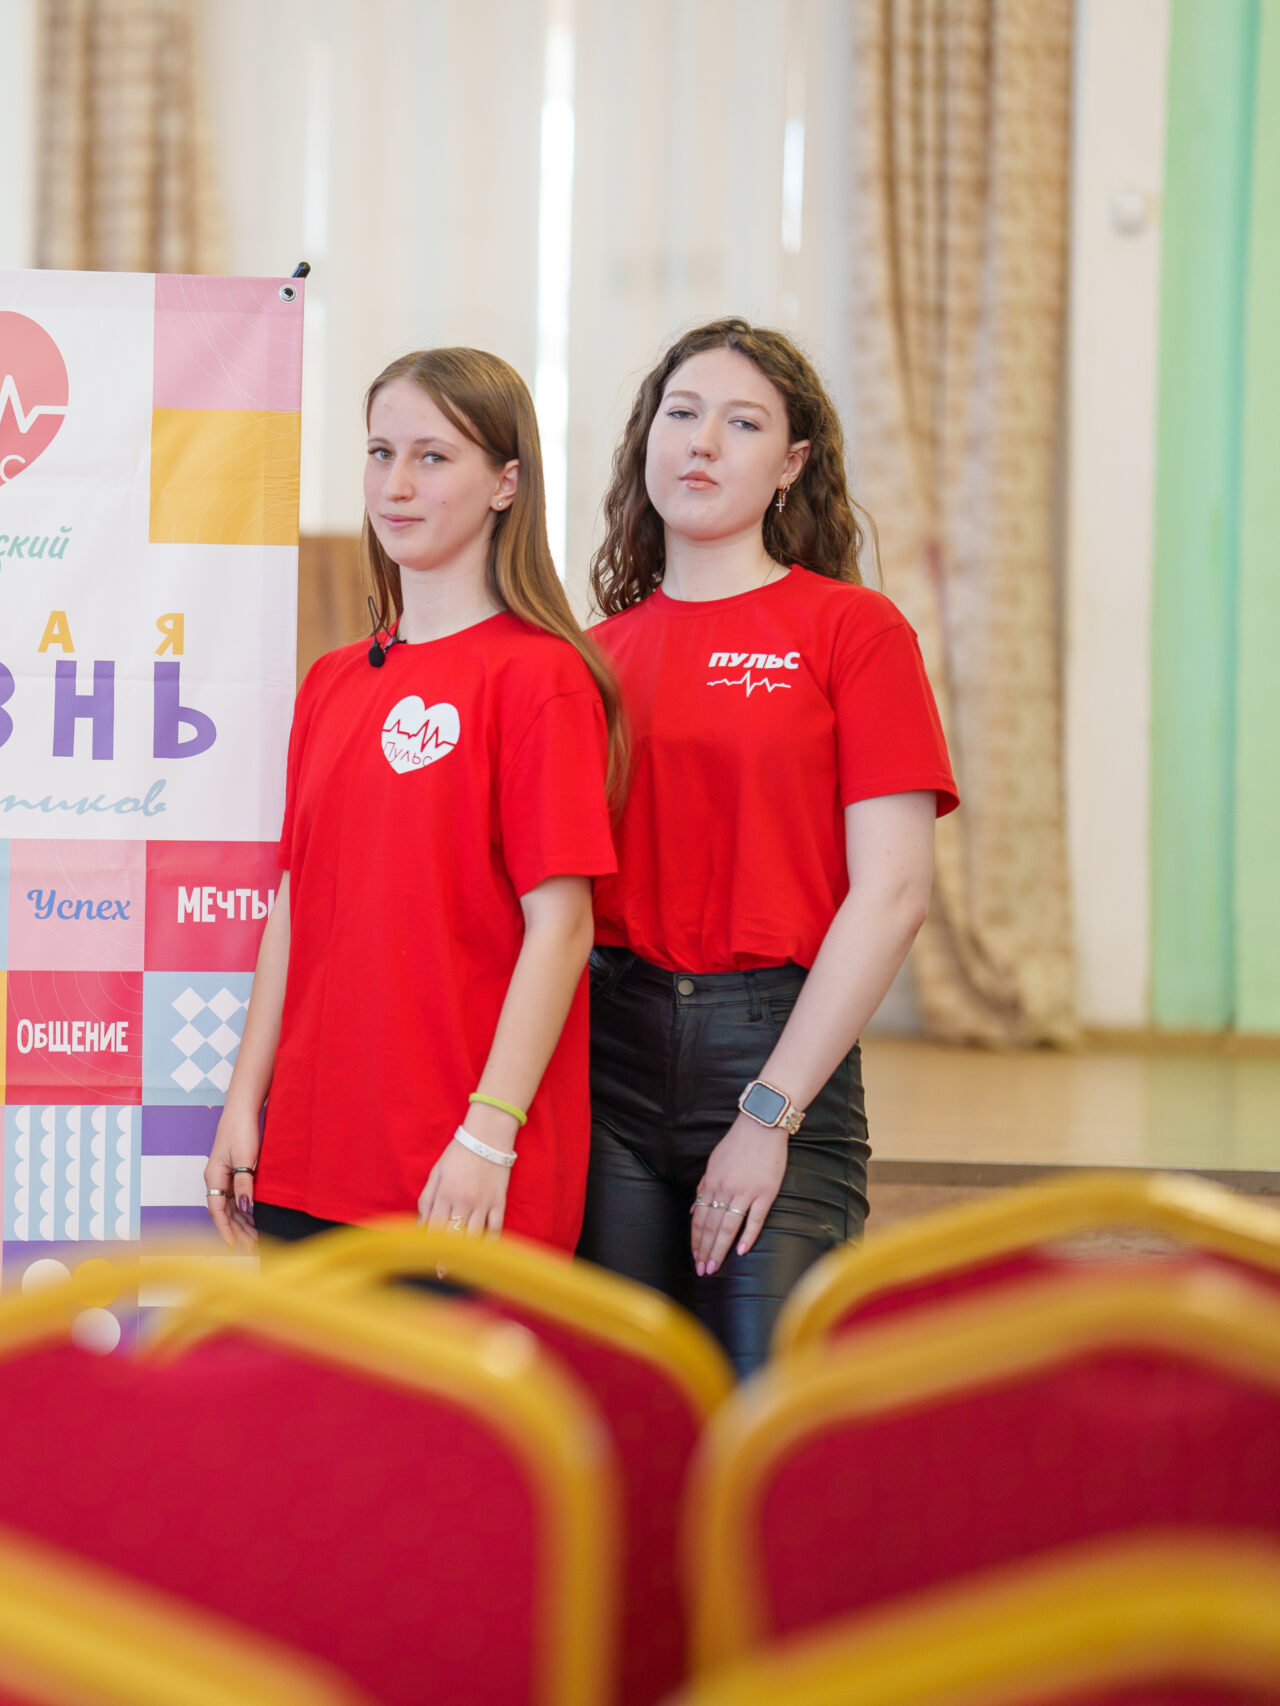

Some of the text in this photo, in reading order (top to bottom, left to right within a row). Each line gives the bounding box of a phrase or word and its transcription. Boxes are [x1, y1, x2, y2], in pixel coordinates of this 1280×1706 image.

[708, 651, 801, 669] ПУЛЬС
[384, 741, 433, 767] Пульс
[26, 889, 130, 920] Успех
[177, 886, 276, 923] МЕЧТЫ
[17, 1018, 129, 1055] ОБЩЕНИЕ
